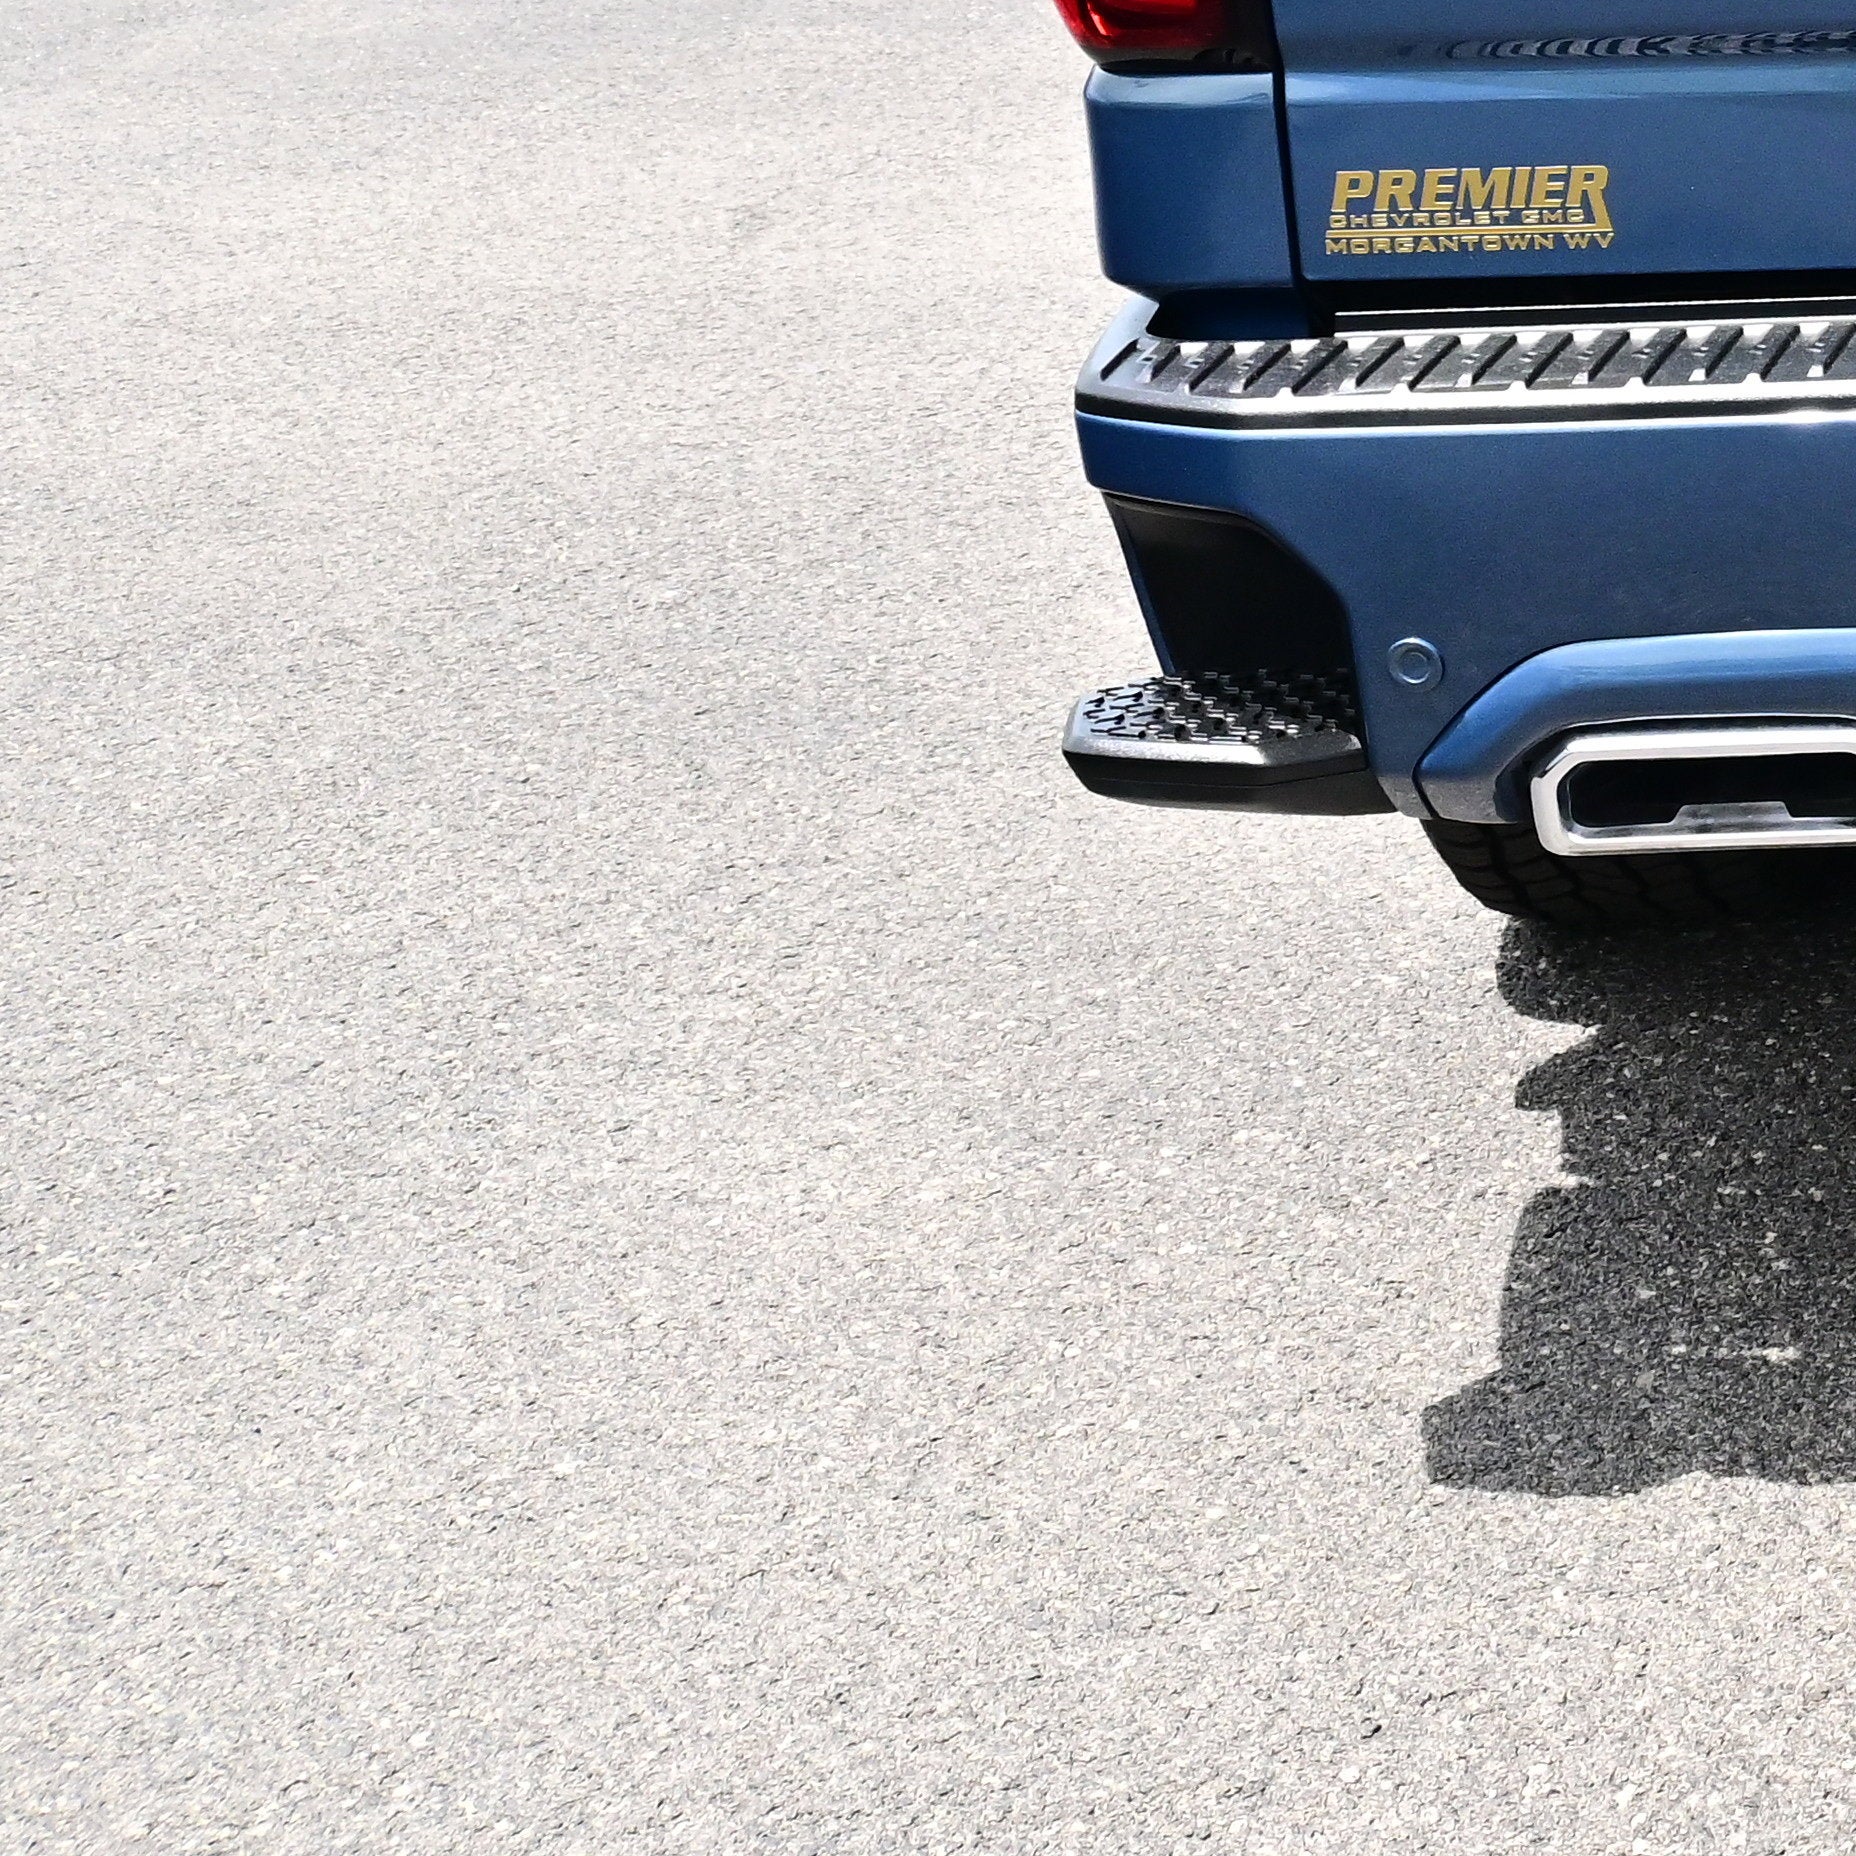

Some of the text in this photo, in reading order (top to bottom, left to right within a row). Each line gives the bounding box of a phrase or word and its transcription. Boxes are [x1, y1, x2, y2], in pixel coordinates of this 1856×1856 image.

[1331, 164, 1613, 230] PREMIER
[1329, 208, 1585, 229] CHEVROLET GMC
[1325, 232, 1614, 255] MORGANTOWN WV
